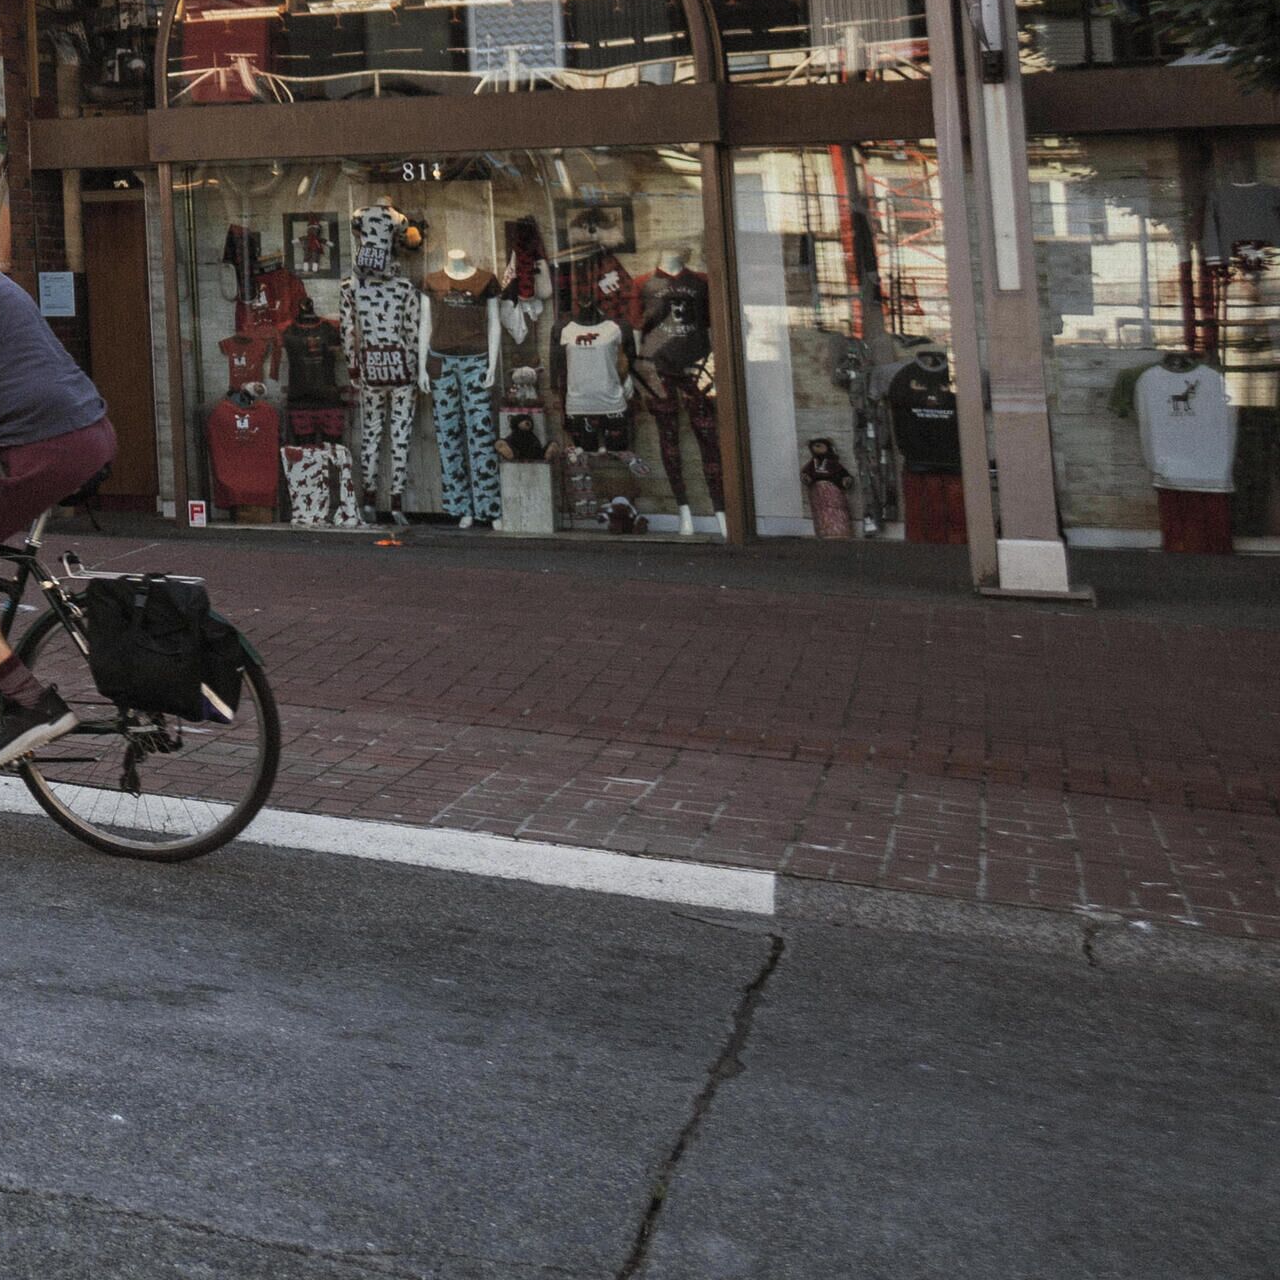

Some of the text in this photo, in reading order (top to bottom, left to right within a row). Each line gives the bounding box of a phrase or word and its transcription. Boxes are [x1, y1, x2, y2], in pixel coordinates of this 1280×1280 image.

[359, 247, 387, 260] BEAR
[357, 257, 385, 270] BUM
[366, 350, 403, 365] BEAR
[366, 365, 406, 382] BUM
